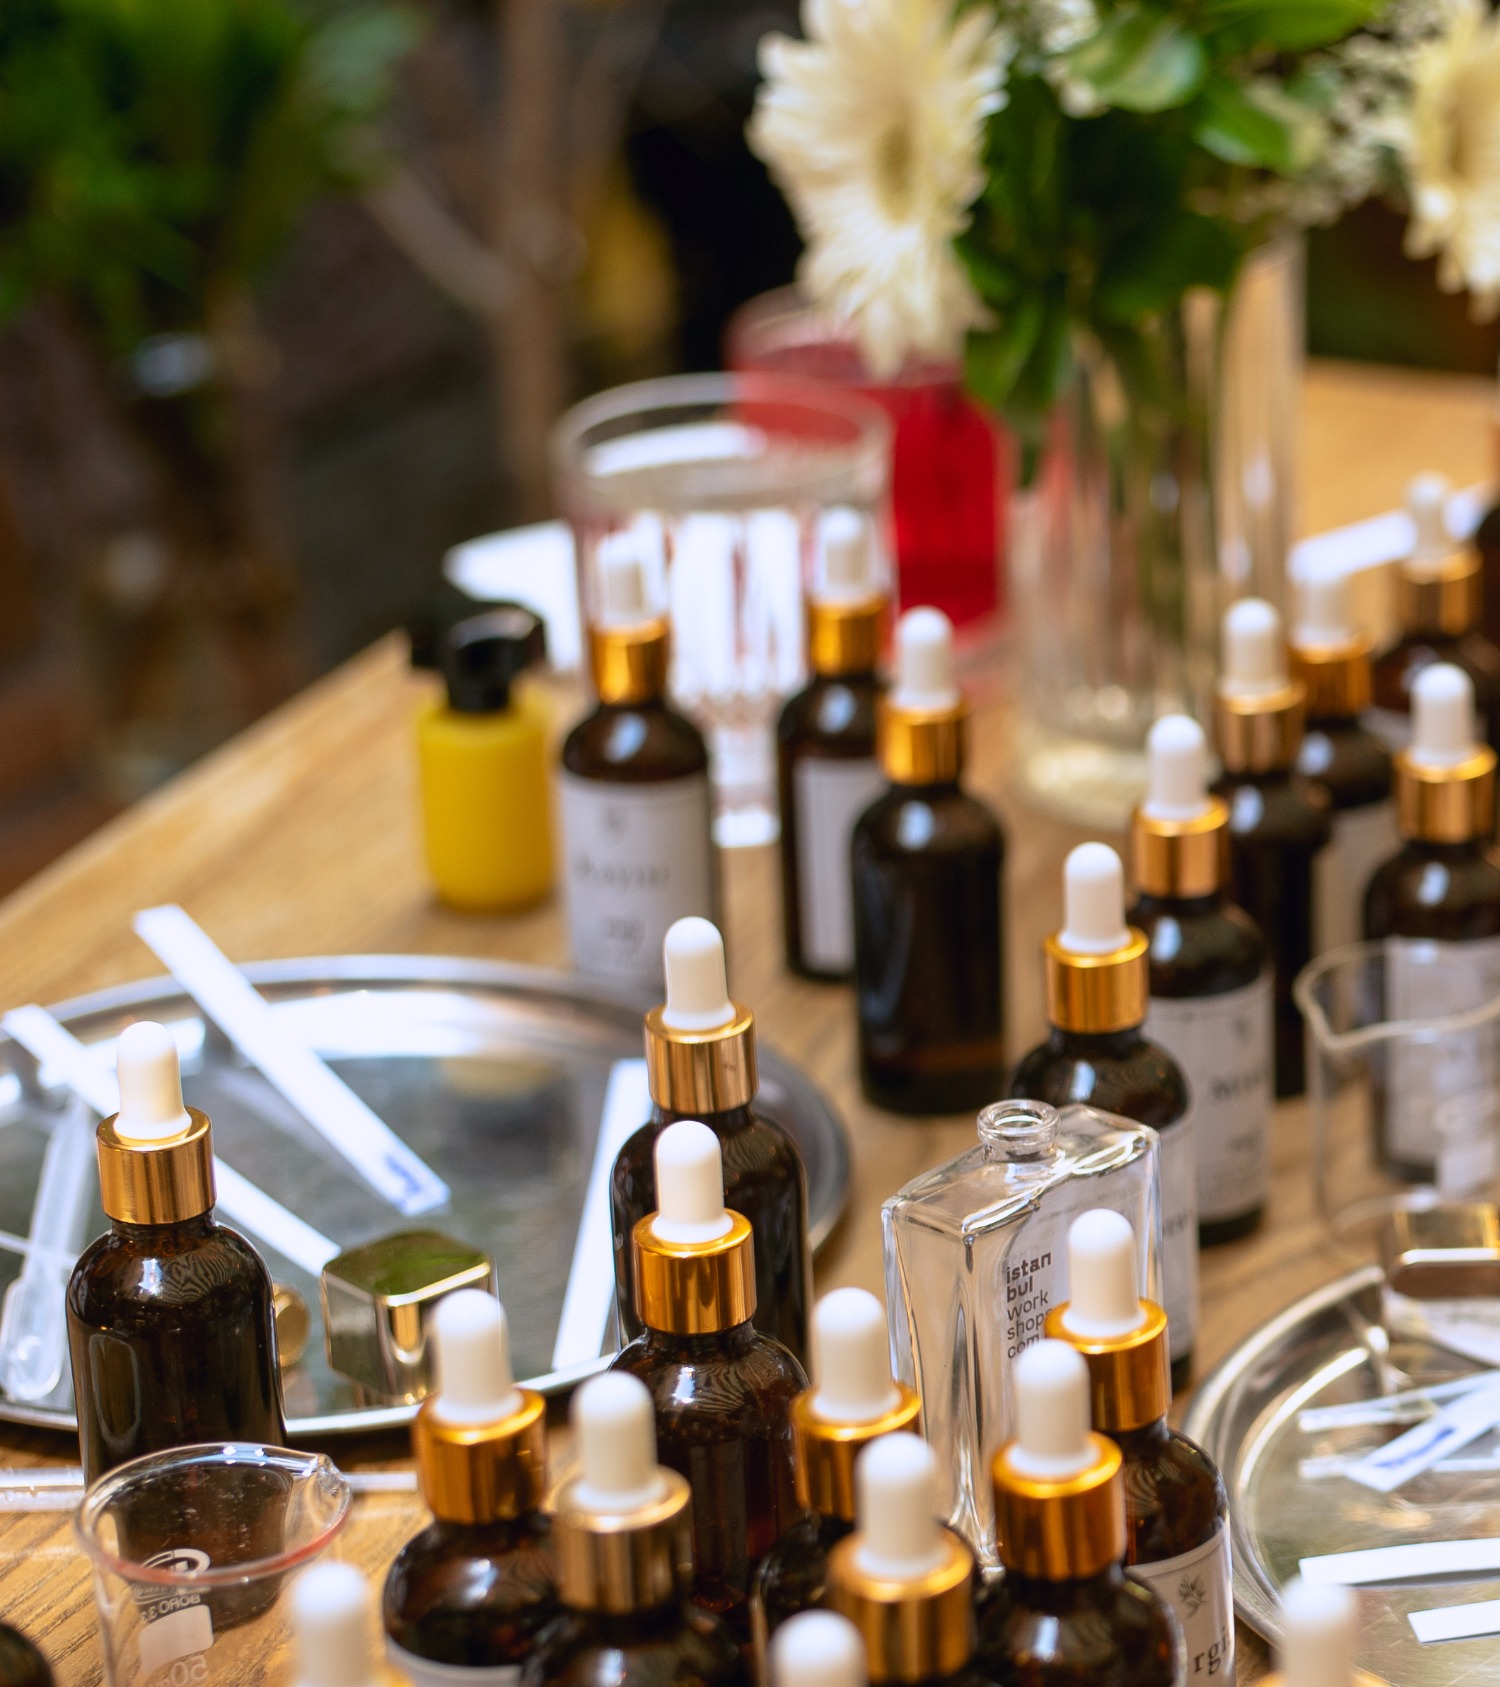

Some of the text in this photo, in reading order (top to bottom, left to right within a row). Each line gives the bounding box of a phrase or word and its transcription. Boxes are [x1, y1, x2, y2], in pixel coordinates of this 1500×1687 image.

[1006, 1253, 1051, 1283] istan
[1006, 1276, 1034, 1303] bul
[1007, 1289, 1049, 1321] work
